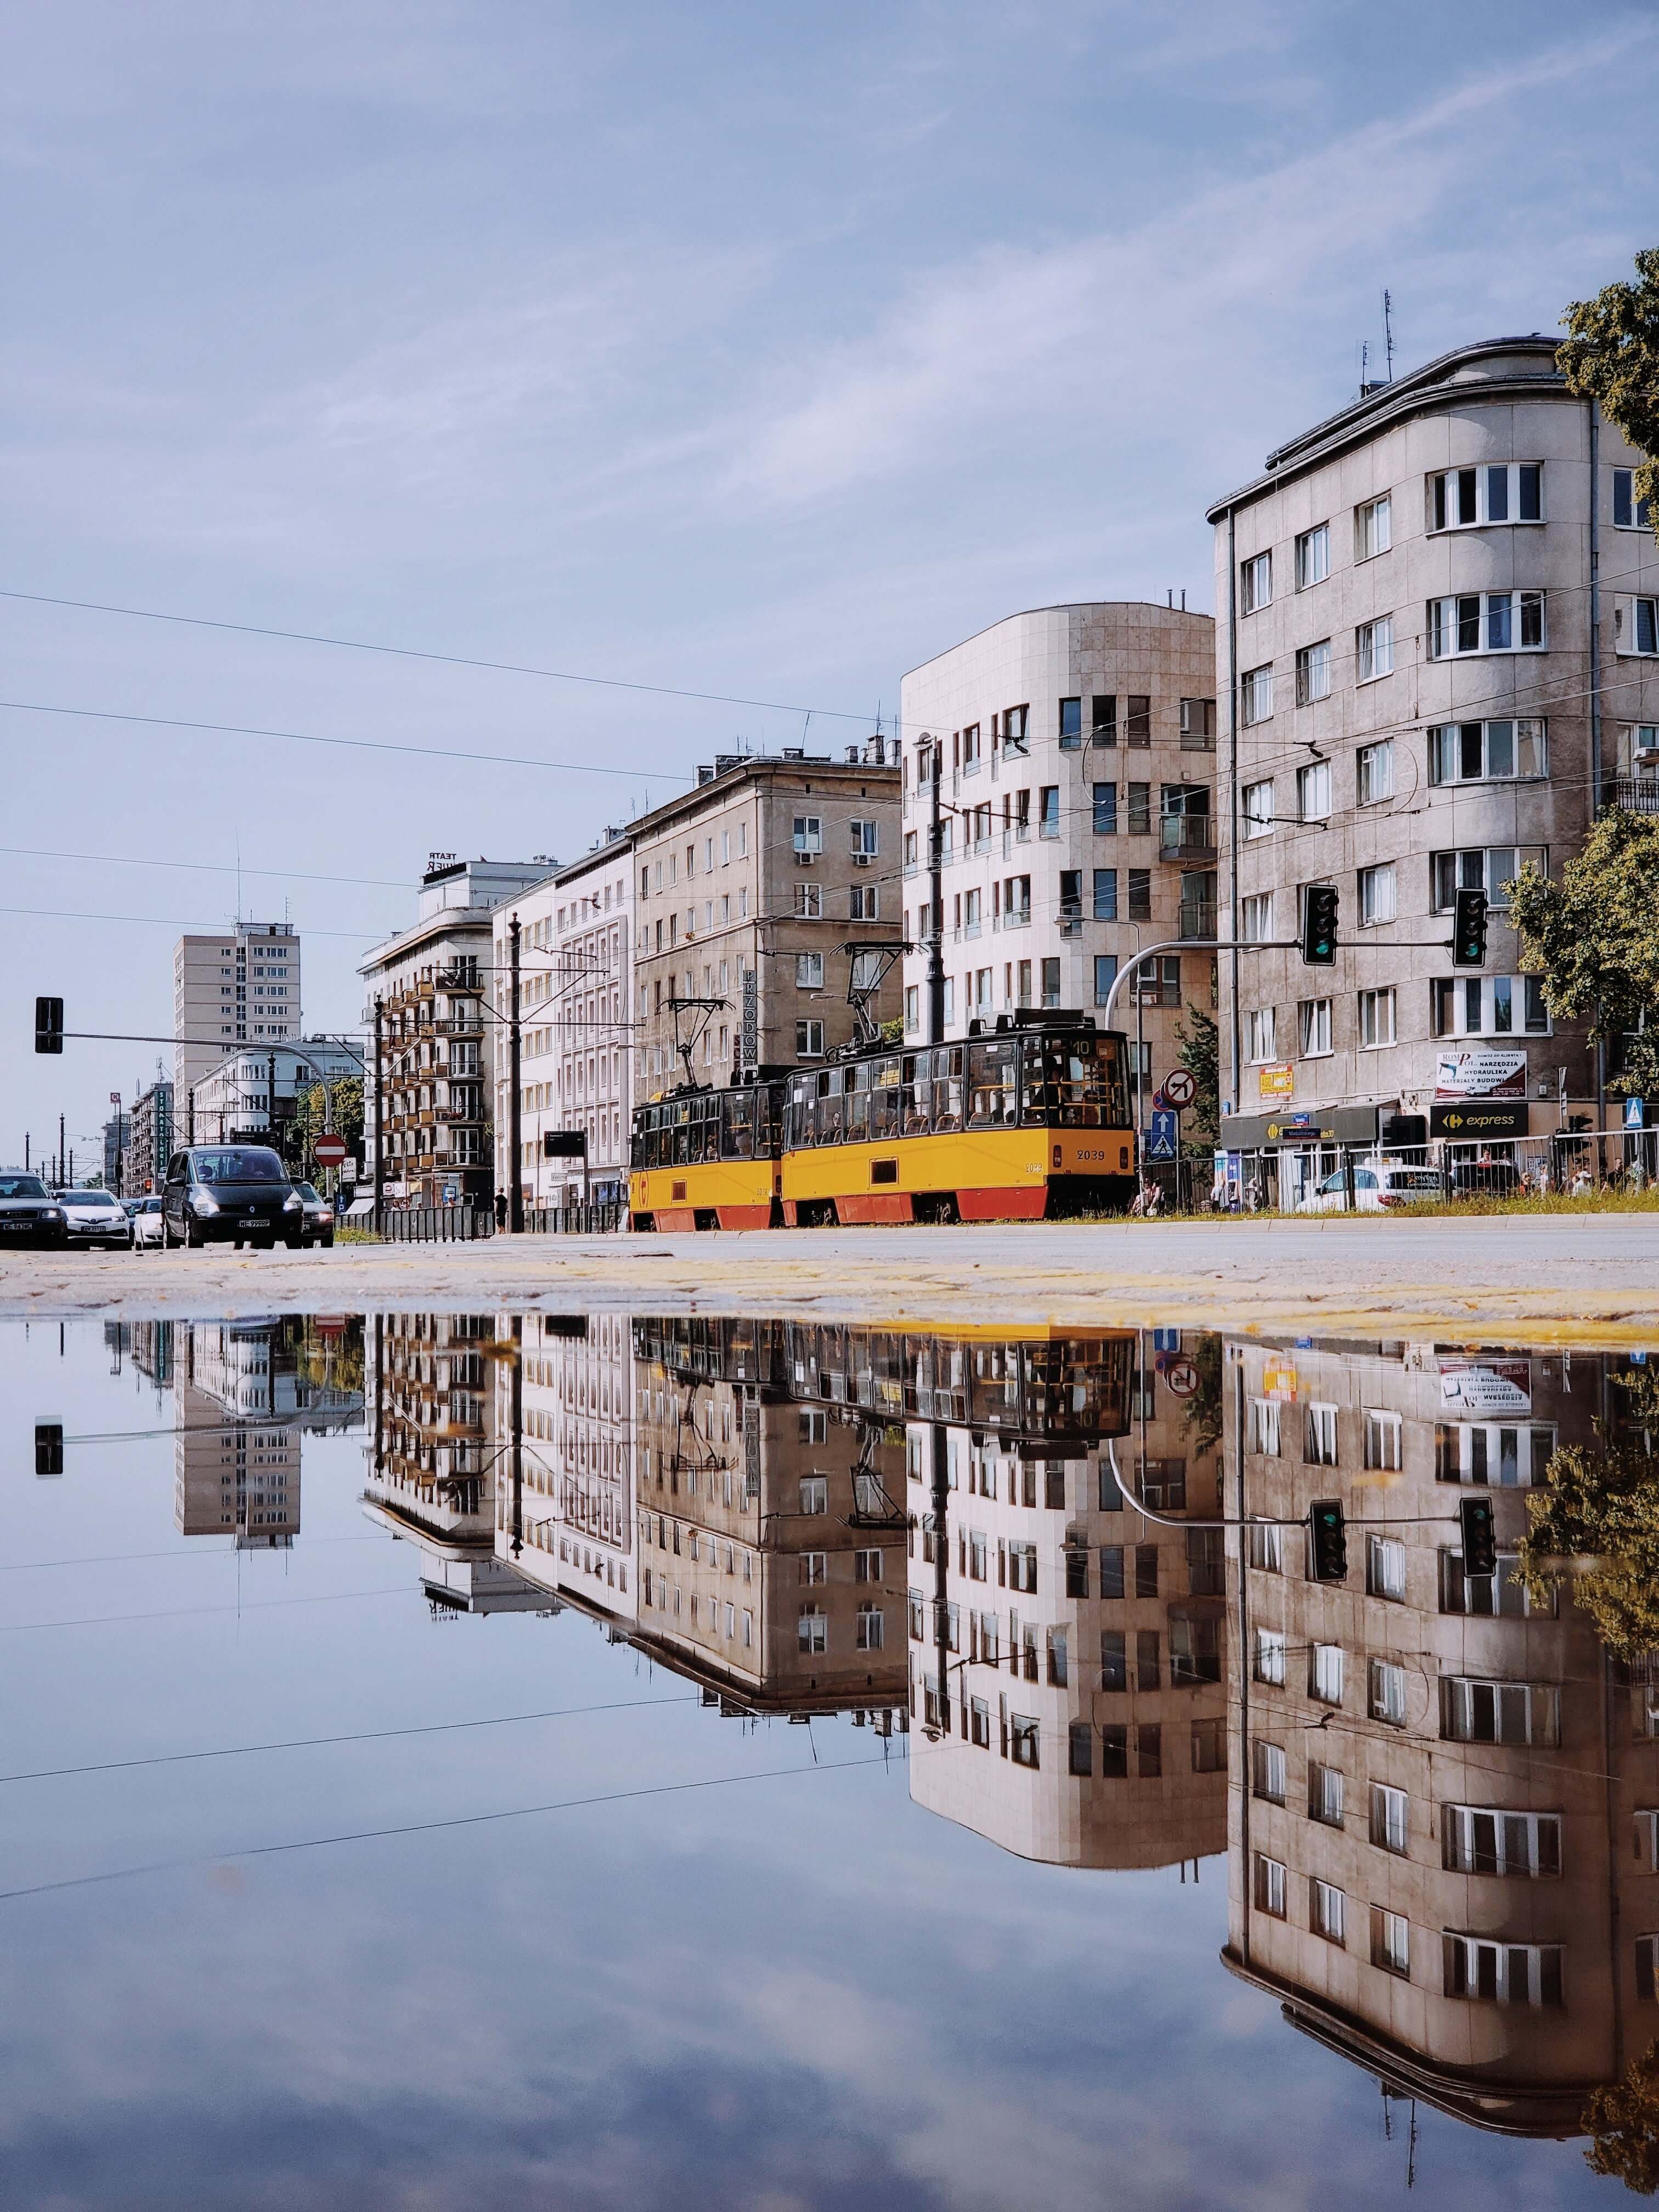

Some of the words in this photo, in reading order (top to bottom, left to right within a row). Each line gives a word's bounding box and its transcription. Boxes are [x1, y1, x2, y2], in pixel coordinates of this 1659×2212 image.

[1073, 1041, 1090, 1054] 10
[1466, 1115, 1515, 1128] express
[1077, 1150, 1105, 1160] 2039
[1025, 1163, 1042, 1172] 2039
